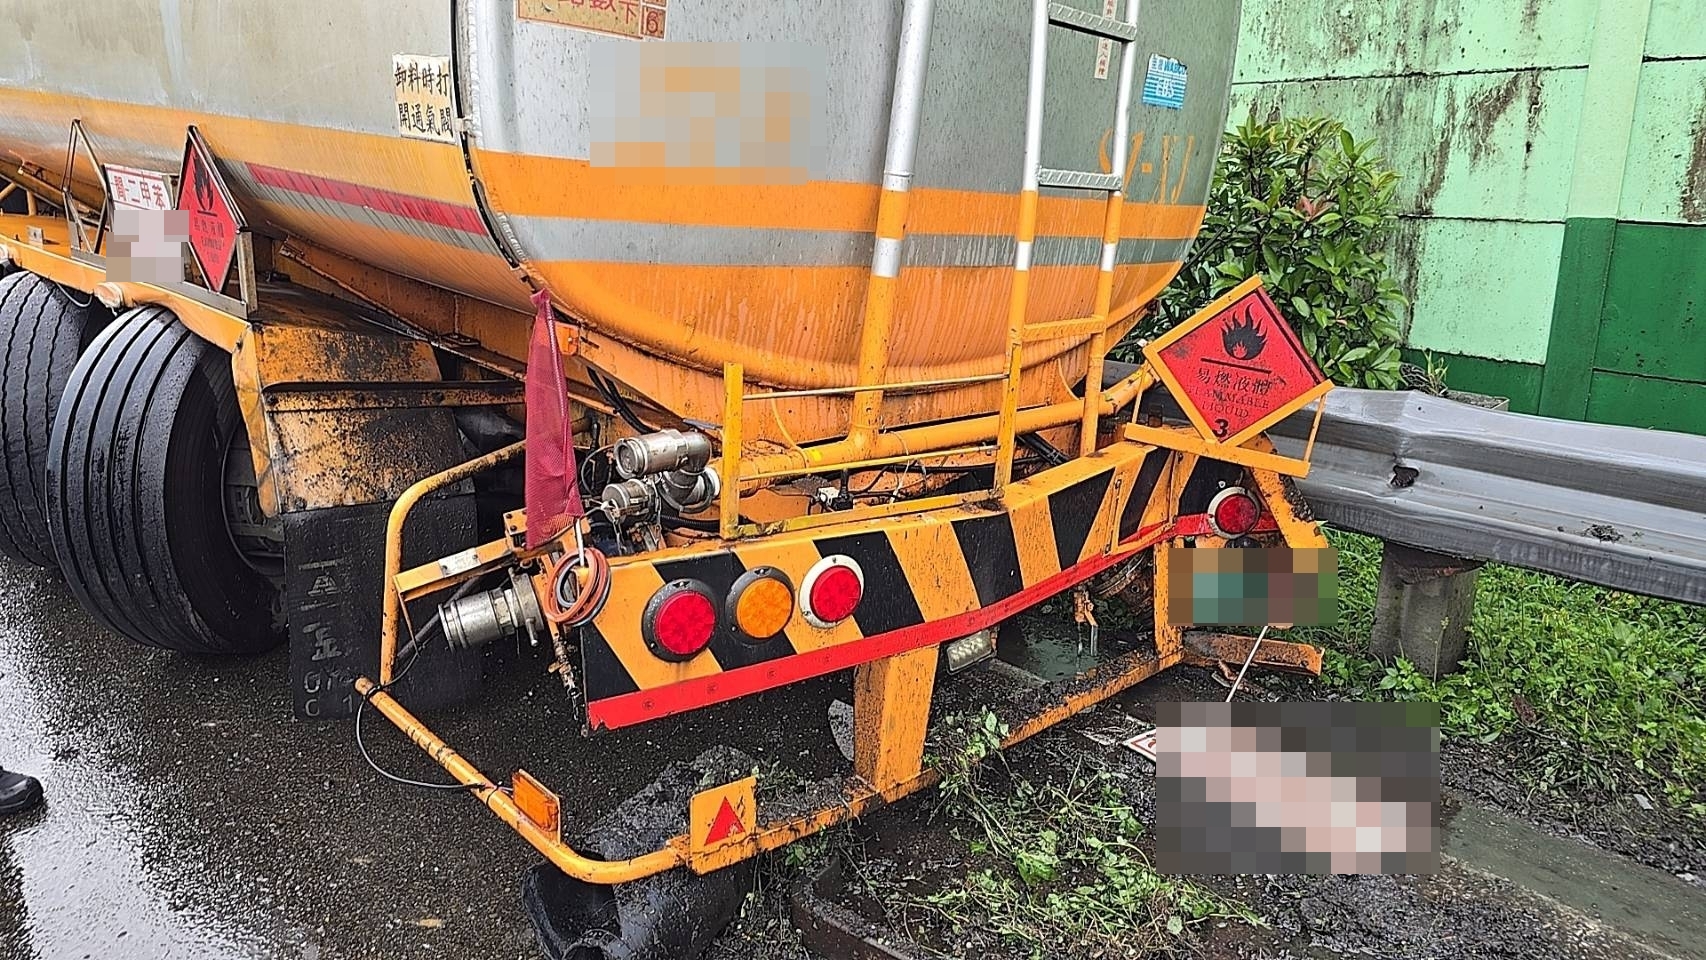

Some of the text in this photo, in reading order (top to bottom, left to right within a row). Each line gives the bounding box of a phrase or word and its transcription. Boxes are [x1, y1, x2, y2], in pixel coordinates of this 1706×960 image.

[394, 61, 449, 96] 卸料時打
[1197, 367, 1272, 396] 易燃液體
[1212, 418, 1229, 438] 3
